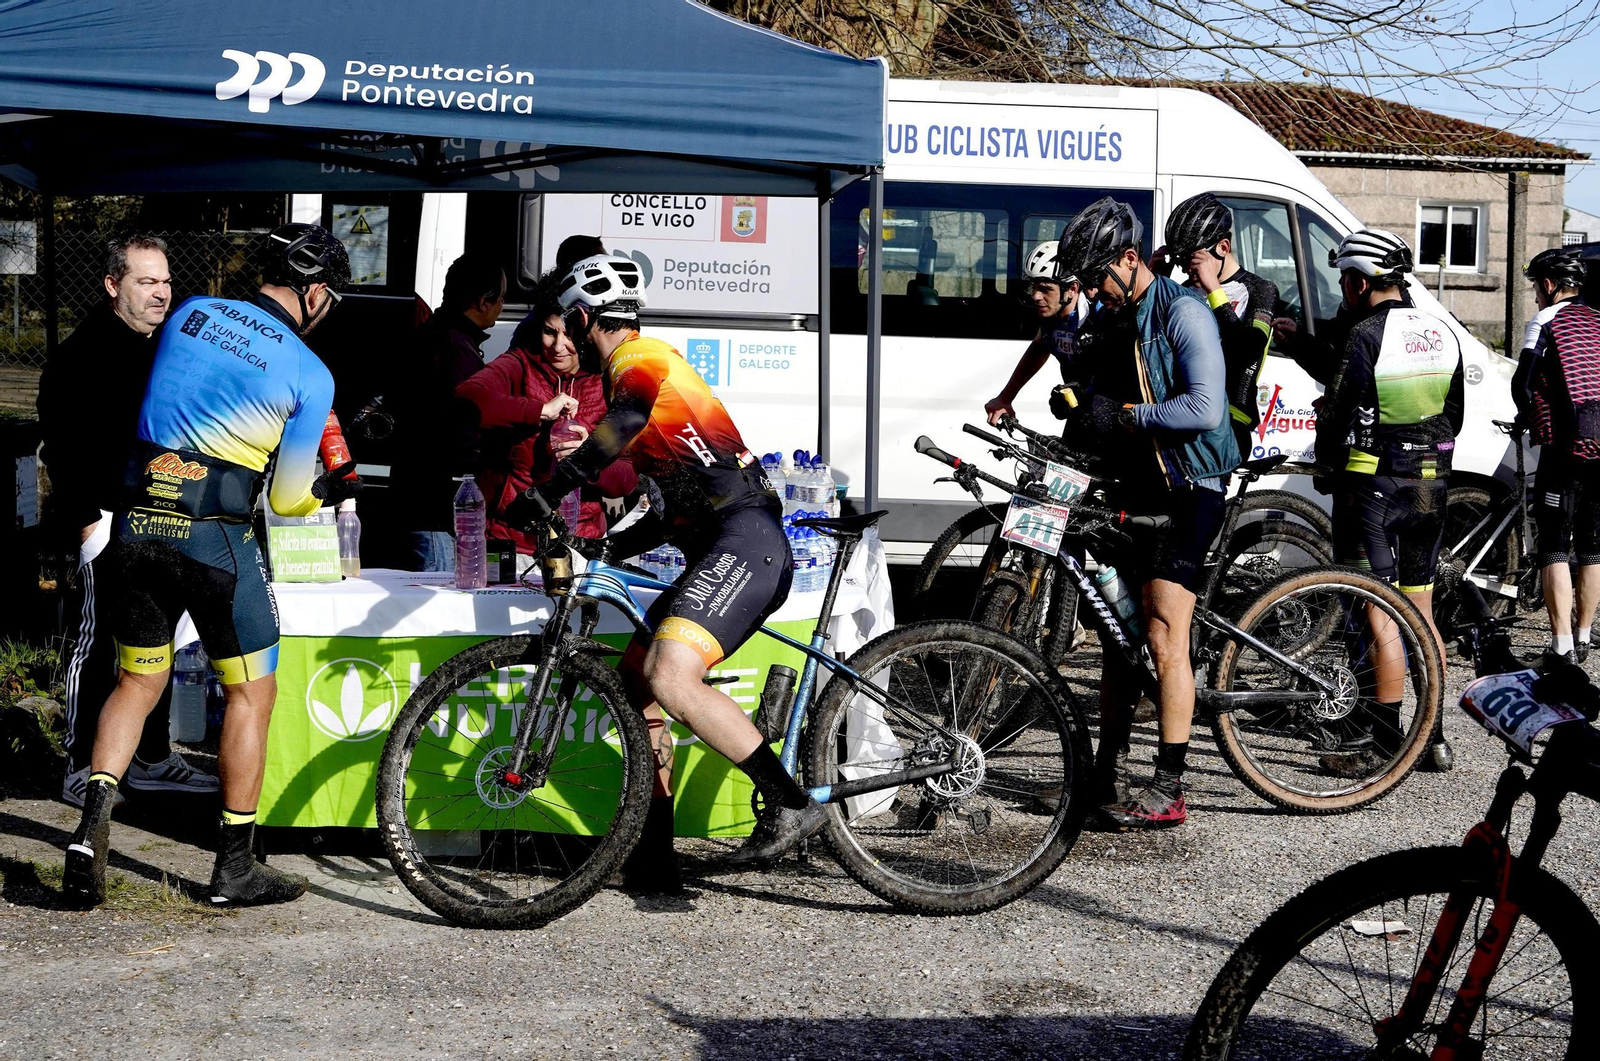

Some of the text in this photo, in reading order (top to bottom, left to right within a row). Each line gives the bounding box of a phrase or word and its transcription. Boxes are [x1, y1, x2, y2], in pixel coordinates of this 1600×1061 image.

[344, 60, 535, 86] Deputación
[341, 79, 534, 115] Pontevedra
[887, 124, 1122, 163] UB CICLISTA VIGUÉS
[610, 193, 707, 210] CONCELLO
[621, 212, 695, 228] DE VIGO
[663, 258, 771, 278] Deputación
[663, 276, 771, 294] Pontevedra
[209, 321, 250, 348] XUNTA
[210, 302, 284, 344] ABANCA
[201, 331, 268, 372] DE GALICIA
[739, 344, 797, 356] DEPORTE
[739, 359, 790, 370] GALEGO
[1257, 384, 1317, 443] Vigué
[1275, 408, 1296, 416] Club
[1285, 449, 1315, 460] @ccvig
[153, 500, 176, 509] ZICO
[148, 527, 190, 540] CICLISMO
[1014, 512, 1055, 544] 471
[277, 556, 285, 576] de
[285, 556, 311, 575] bienestar
[685, 577, 716, 611] Mil
[711, 565, 746, 612] INMOBILIARIA
[1065, 555, 1132, 648] S-WORK
[679, 625, 711, 653] TOXO
[1481, 686, 1541, 736] 69
[388, 823, 425, 882] MAXXIS
